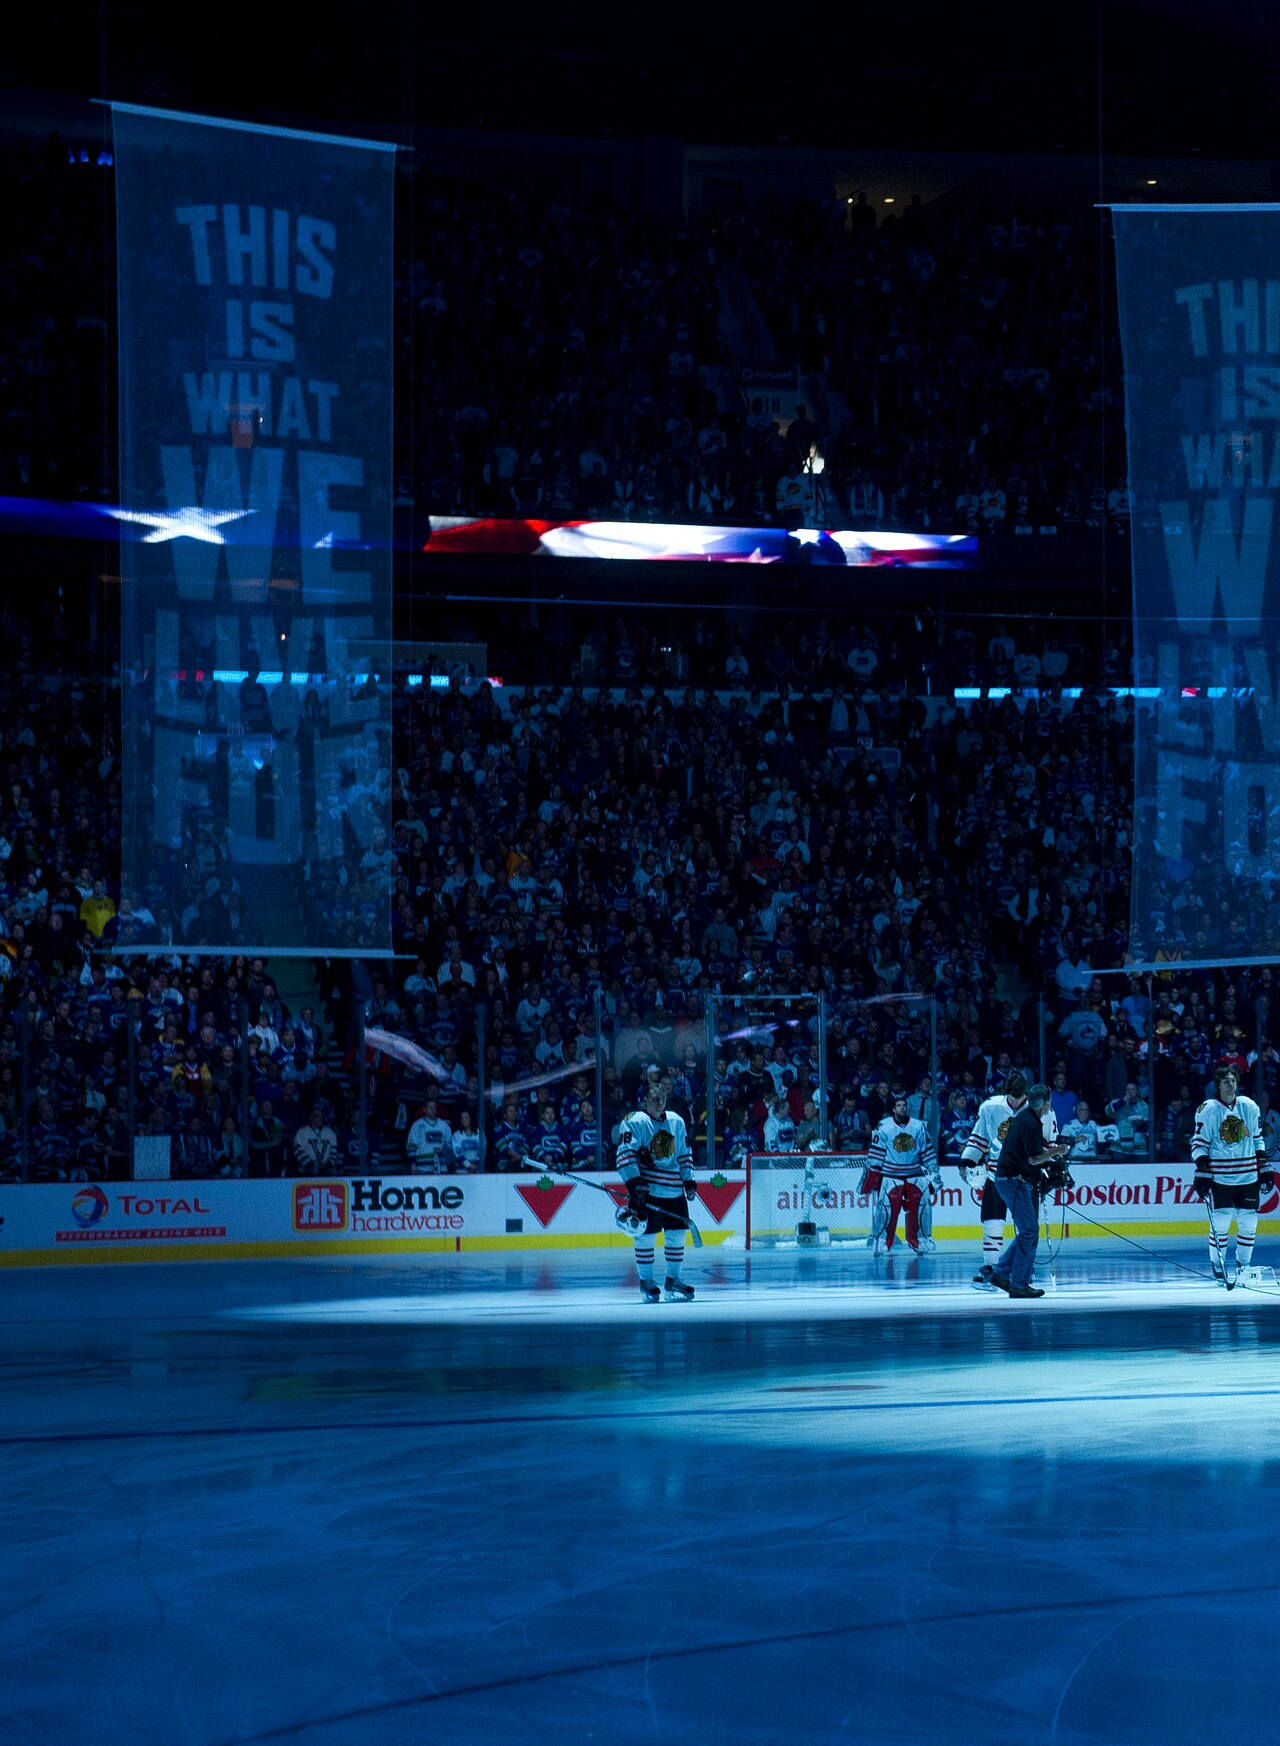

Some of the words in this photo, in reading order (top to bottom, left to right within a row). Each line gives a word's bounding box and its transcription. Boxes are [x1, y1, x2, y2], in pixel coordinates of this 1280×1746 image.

[174, 203, 338, 298] THIS
[225, 298, 295, 362] IS
[183, 372, 338, 443] WHAT
[159, 446, 375, 603] WE
[154, 608, 380, 740] LIVE
[153, 726, 390, 864] FOR
[118, 1194, 211, 1215] TOTAL
[351, 1179, 464, 1211] Home
[352, 1212, 464, 1232] hardware
[1053, 1180, 1150, 1206] Boston
[61, 1230, 142, 1242] PERFORMANCE
[147, 1229, 189, 1239] ENGINE
[195, 1227, 222, 1237] OILS
